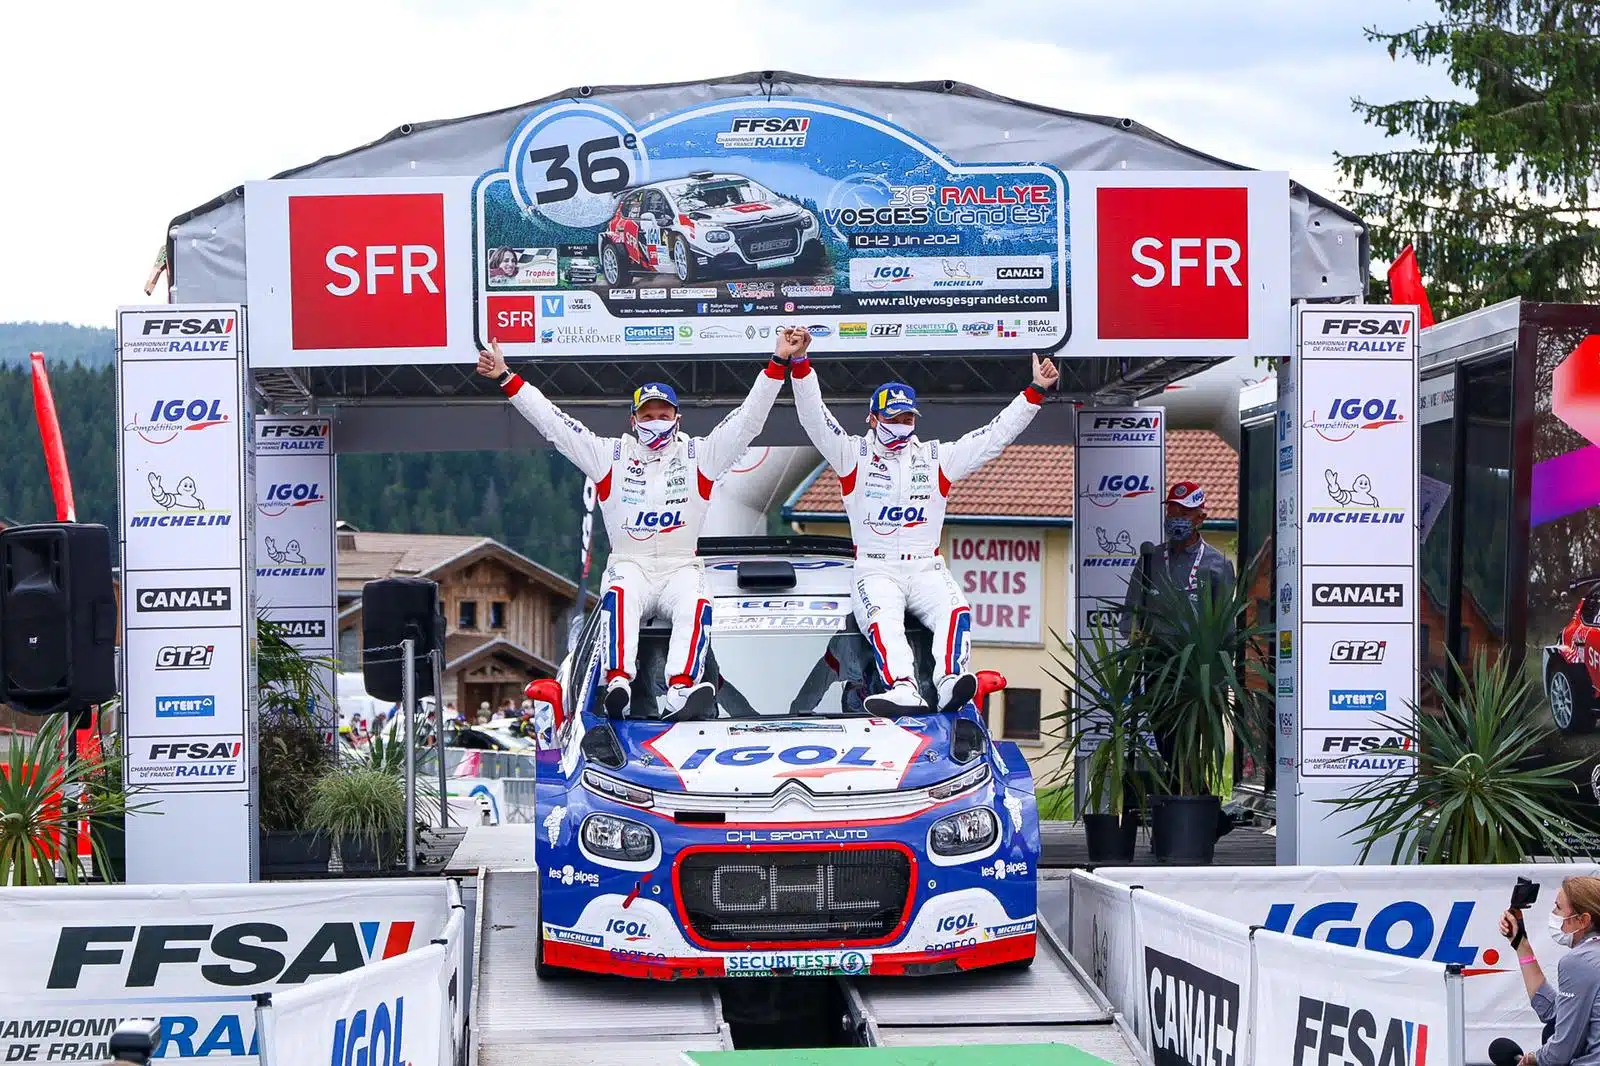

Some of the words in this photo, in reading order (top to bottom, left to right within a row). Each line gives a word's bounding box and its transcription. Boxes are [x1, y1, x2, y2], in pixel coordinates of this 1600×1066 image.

[732, 118, 799, 132] FFSA
[755, 137, 805, 146] RALLYE
[941, 186, 1050, 205] RALLYE
[823, 207, 928, 227] VOSGES
[936, 205, 1006, 225] Grand
[1011, 205, 1050, 225] Est
[855, 235, 890, 246] 10-12
[923, 234, 960, 245] 2021
[1130, 236, 1243, 288] SFR
[325, 244, 440, 296] SFR
[525, 269, 556, 277] Trophée
[998, 268, 1043, 278] CANAL+
[857, 294, 1048, 309] www.rallyevosgesgrandest.com
[497, 311, 533, 328] SFR
[142, 319, 223, 335] FFSA
[557, 326, 585, 335] VILLE
[587, 326, 598, 335] de
[1321, 319, 1401, 335] FFSA
[168, 340, 229, 352] RALLYE
[1347, 341, 1406, 352] RALLYE
[124, 421, 183, 433] Compétition
[1093, 417, 1151, 429] FFSA
[1302, 419, 1359, 430] Compétition
[261, 425, 320, 437] FFSA
[1112, 433, 1156, 441] RALLYE
[280, 440, 325, 450] RALLYE
[130, 514, 231, 528] MICHELIN
[1306, 512, 1404, 524] MICHELIN
[951, 538, 1041, 562] LOCATION
[1082, 558, 1137, 567] MICHEL
[256, 567, 326, 577] MICHELIN
[963, 570, 1027, 594] SKIS
[139, 590, 228, 609] CANAL+
[1315, 586, 1400, 603] CANAL+
[767, 616, 841, 626] TEAM
[976, 604, 1031, 628] URF
[155, 645, 215, 668] GT2i
[1329, 640, 1387, 662] GT2i
[1322, 736, 1400, 752] FFSA
[149, 743, 231, 760] FFSA
[130, 765, 176, 773] CHAMPIONNAT
[175, 764, 236, 777] RALLYE
[1347, 758, 1406, 770] RALLYE
[726, 831, 767, 842] CHL
[770, 830, 823, 841] SPORT
[825, 829, 868, 840] AUTO
[712, 864, 880, 911] CHL
[996, 921, 1034, 934] MICHELIN
[558, 931, 602, 944] MICHELIN
[46, 921, 366, 990] FFSA
[728, 953, 836, 970] SECURITEST
[1149, 966, 1238, 1066] CANAL+
[1293, 995, 1407, 1066] FFSA
[5, 1043, 41, 1062] DE
